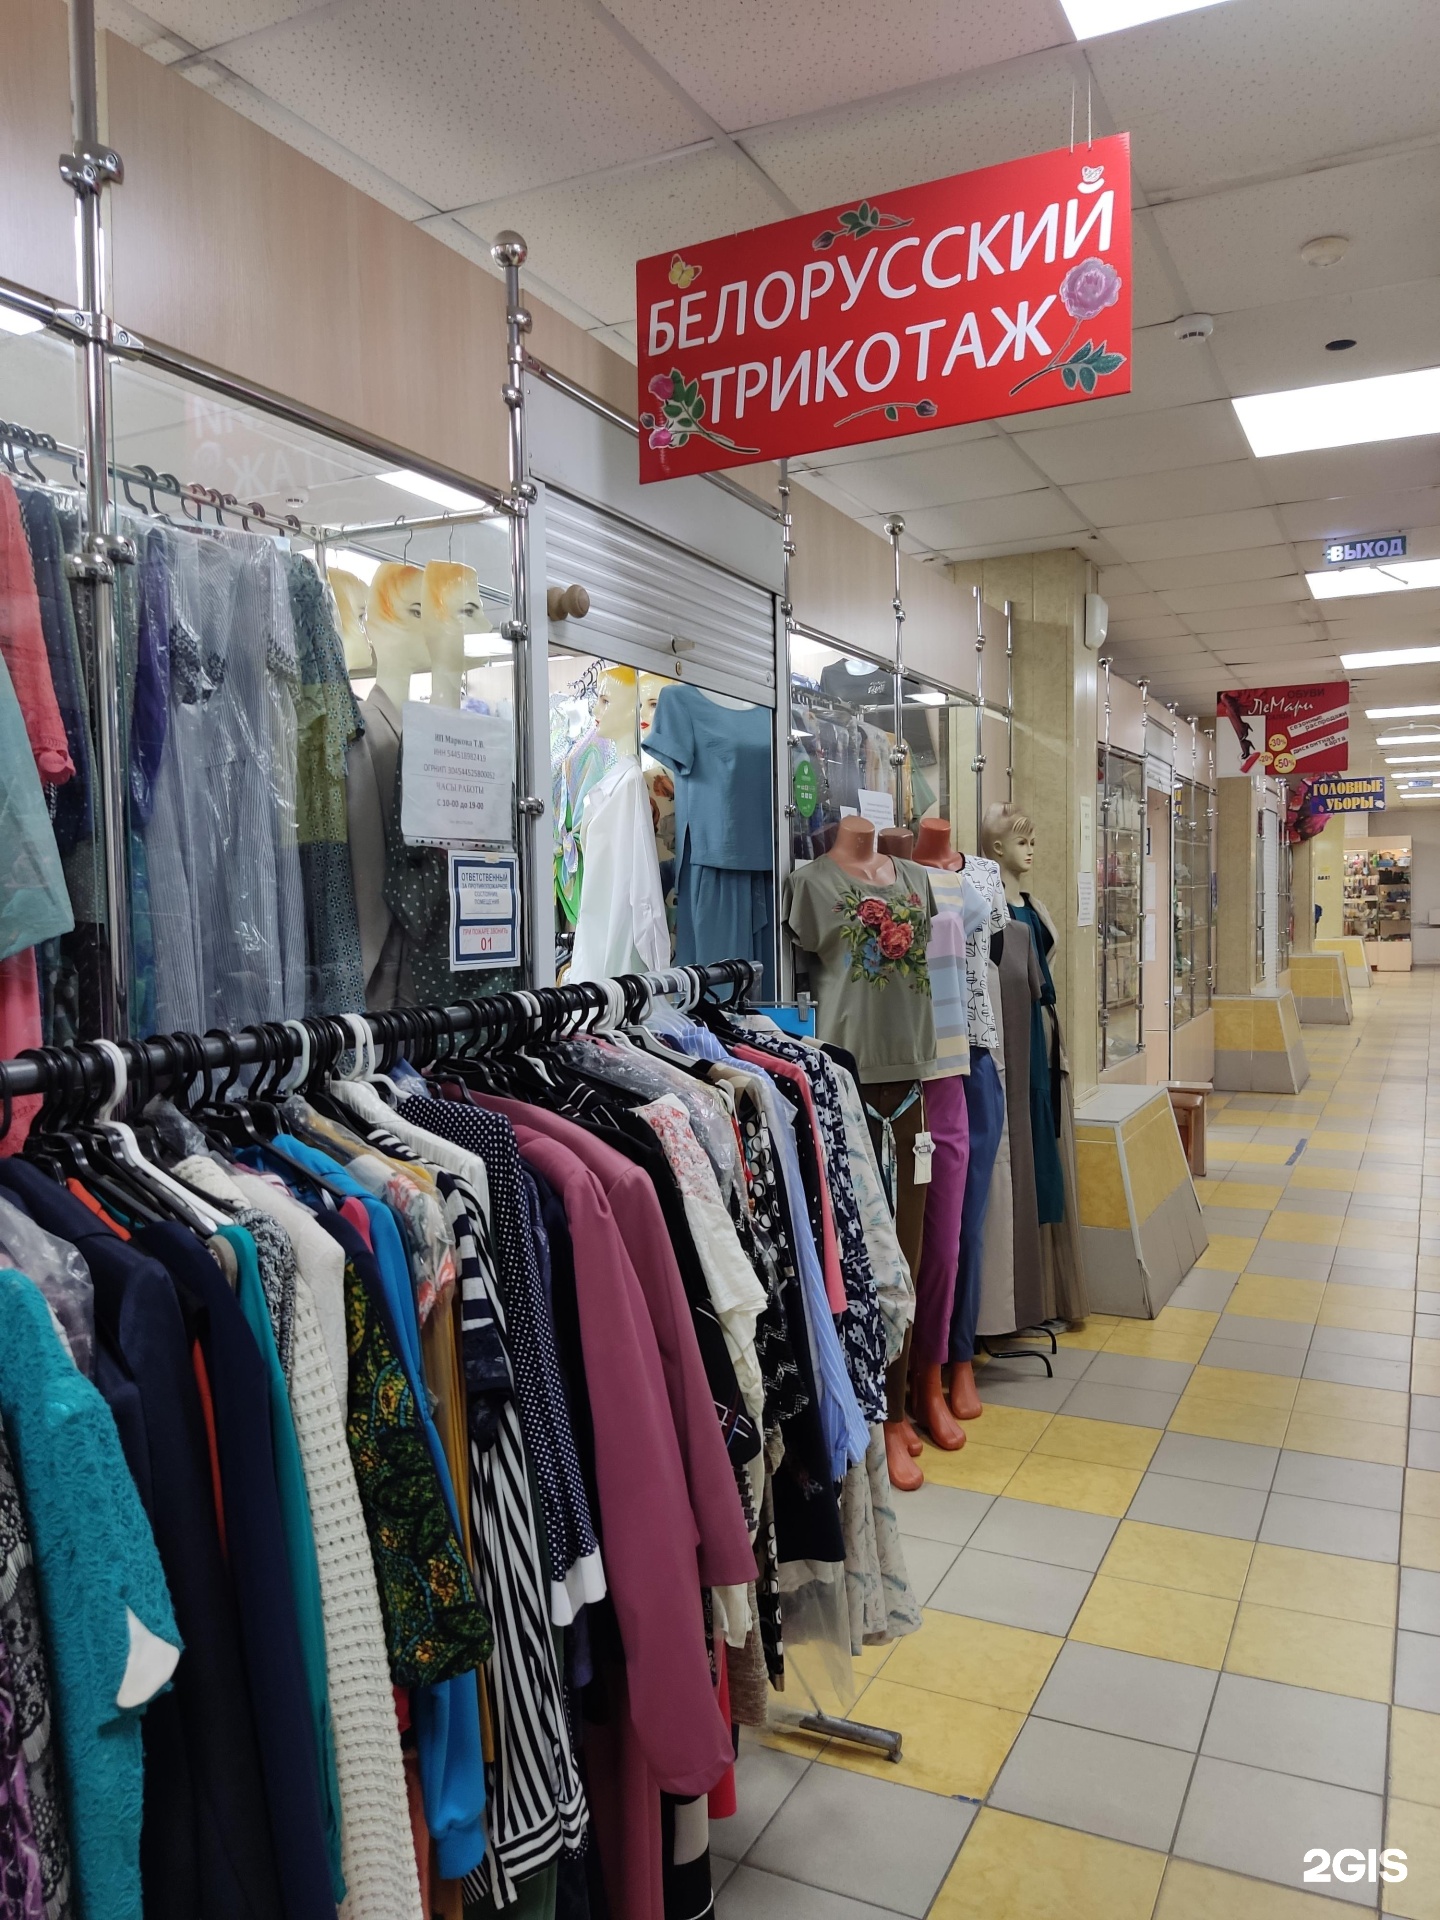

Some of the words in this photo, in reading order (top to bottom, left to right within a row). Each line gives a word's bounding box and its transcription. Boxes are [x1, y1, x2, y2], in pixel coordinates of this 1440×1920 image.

[648, 178, 1115, 357] БЕЛОРУССКИЙ
[701, 295, 1057, 424] ТРИКОТАЖ
[1330, 538, 1404, 562] ВЫХОД
[1287, 688, 1325, 699] ОБУВИ
[1305, 711, 1348, 732] распродажи
[1293, 735, 1335, 755] дисконтная
[1324, 736, 1346, 748] карта
[436, 782, 457, 792] ЧАСЫ
[458, 783, 484, 794] РАБОТЫ
[1313, 780, 1383, 797] ГОЛОВНЫЕ
[1326, 796, 1374, 812] УБОРЫ
[461, 872, 508, 882] ОТВЕТСТВЕННЫЙ
[481, 937, 492, 951] 01
